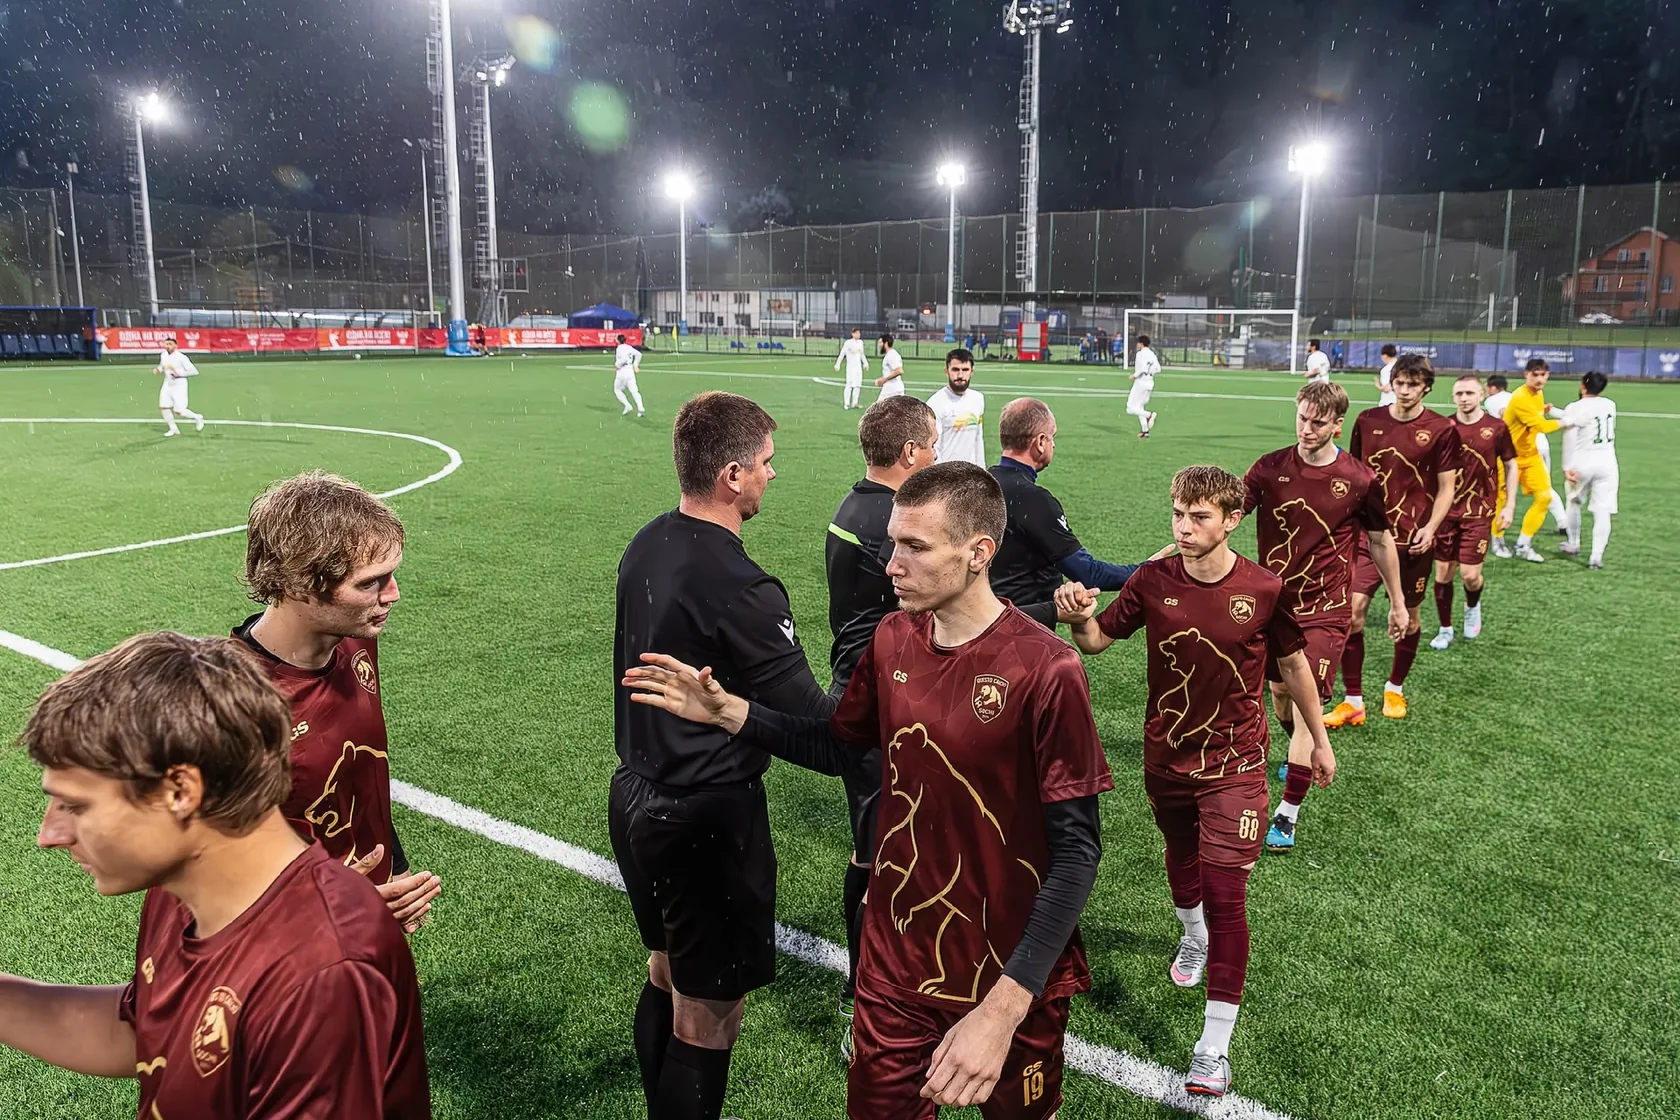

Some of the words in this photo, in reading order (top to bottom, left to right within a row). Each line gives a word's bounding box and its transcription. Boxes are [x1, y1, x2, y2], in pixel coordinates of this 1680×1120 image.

[1164, 597, 1179, 606] GS
[893, 670, 908, 683] GS
[1242, 809, 1258, 817] GS
[1238, 816, 1260, 842] 88
[1022, 1060, 1043, 1077] GS
[1023, 1071, 1044, 1107] 19
